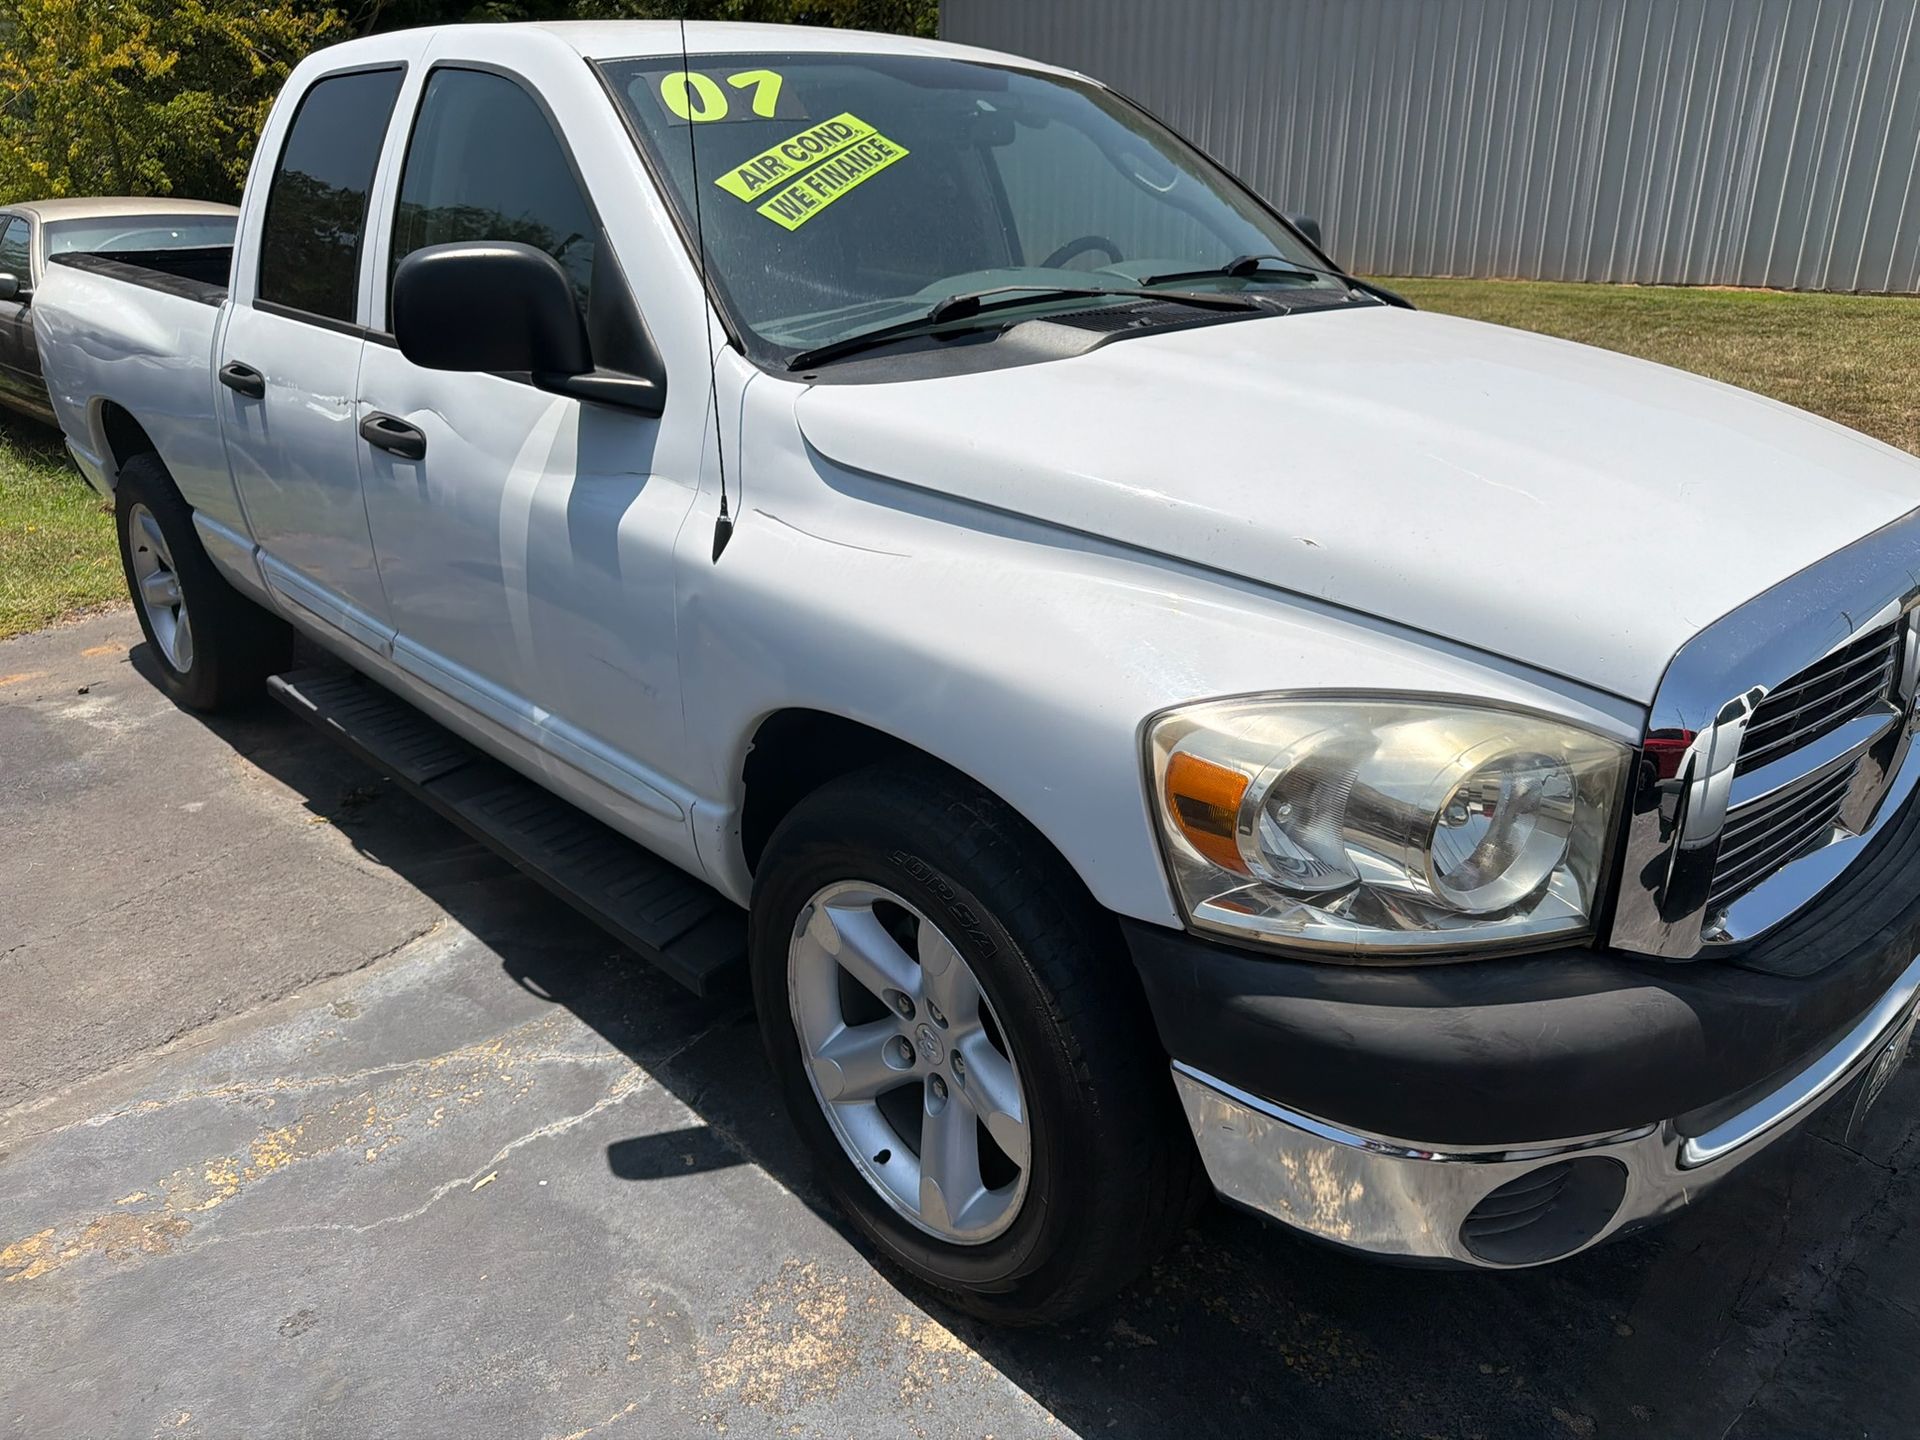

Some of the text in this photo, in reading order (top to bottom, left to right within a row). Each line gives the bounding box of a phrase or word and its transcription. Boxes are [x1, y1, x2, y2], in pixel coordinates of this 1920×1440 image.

[660, 69, 783, 122] 07
[738, 121, 864, 192] AIR COND.
[768, 137, 898, 222] WE FINANCE
